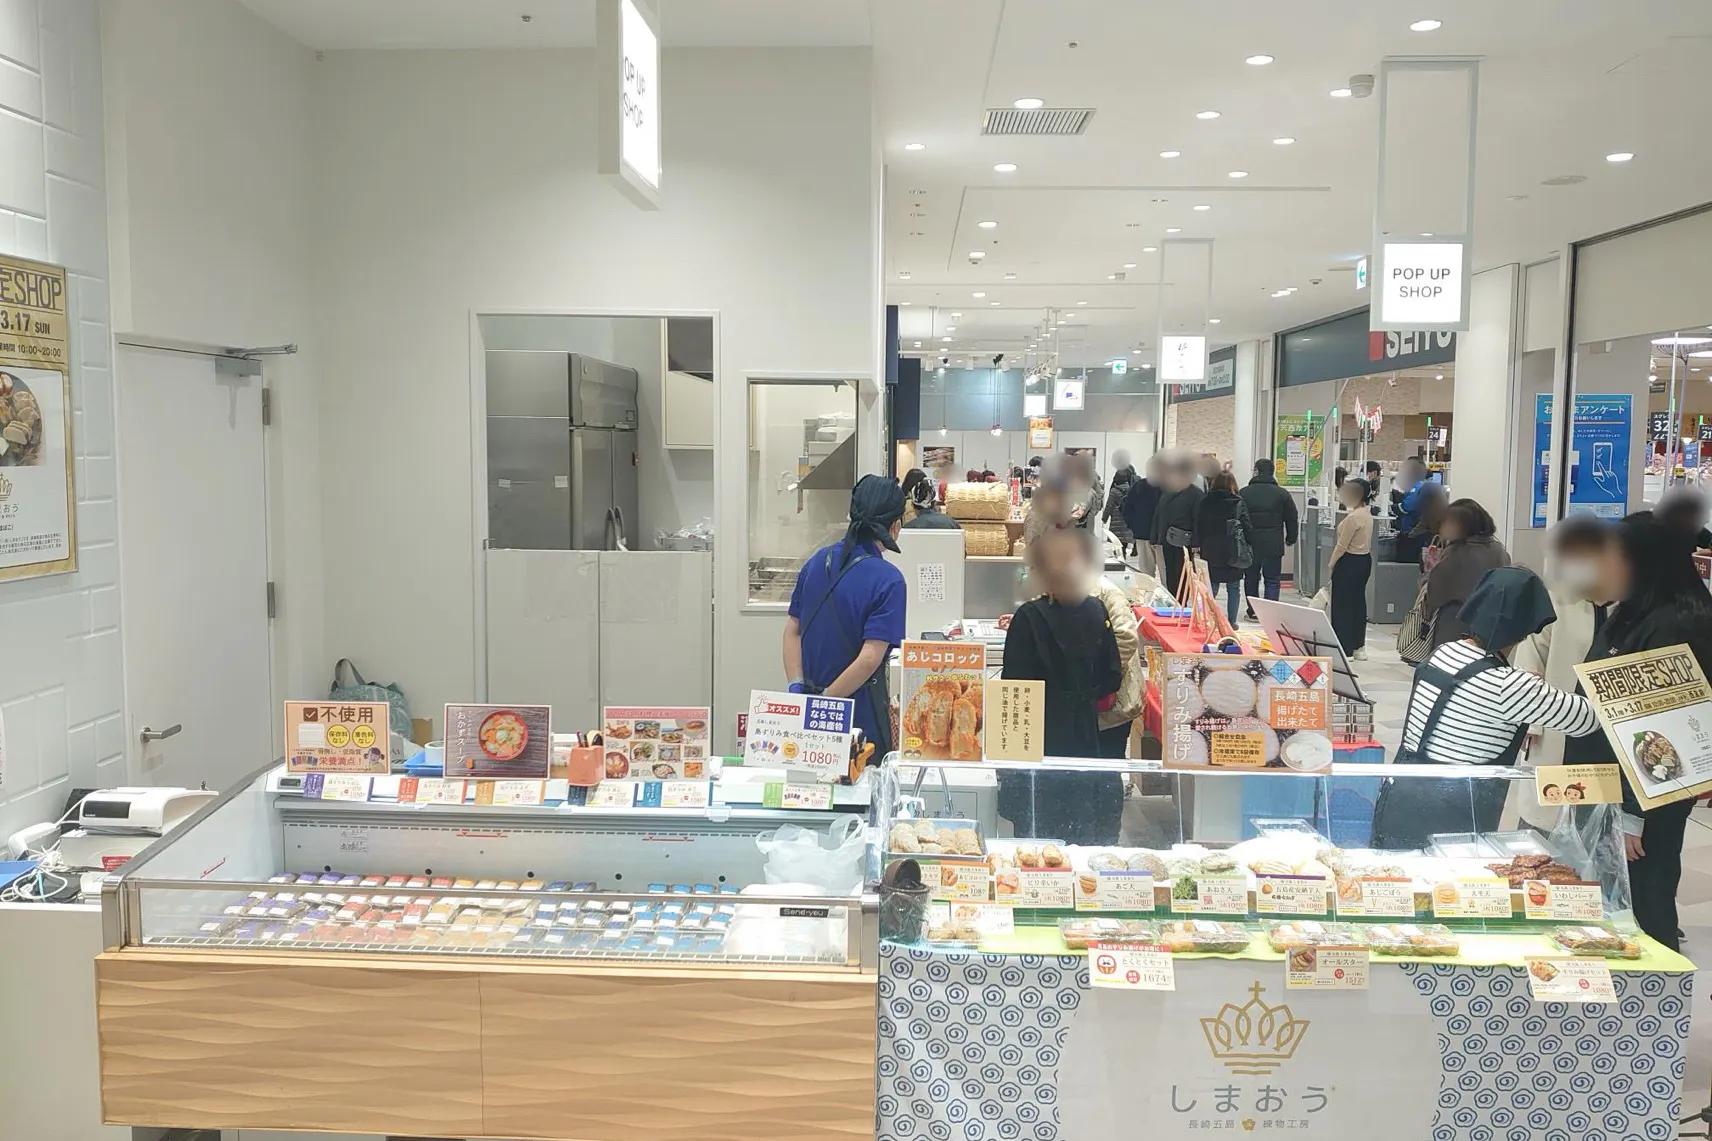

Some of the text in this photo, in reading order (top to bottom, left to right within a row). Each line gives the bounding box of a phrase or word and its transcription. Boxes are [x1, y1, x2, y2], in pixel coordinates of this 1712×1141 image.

[624, 56, 646, 96] OP UP
[623, 92, 644, 128] SHOP
[1393, 268, 1451, 280] POP UP
[1399, 286, 1443, 298] SHOP
[35, 321, 51, 335] SUN
[0, 342, 16, 352] 時間
[1544, 405, 1626, 414] おまアンケート
[1653, 420, 1670, 432] 32
[1428, 431, 1439, 439] 24
[1701, 430, 1712, 439] 21
[906, 650, 981, 665] あじコロッケ
[1274, 690, 1320, 703] 長崎五島
[811, 699, 845, 711] 長崎五島
[1012, 686, 1020, 732] 使用した商品と
[1276, 704, 1319, 716] 揚げたて
[320, 706, 374, 723] 不使用
[810, 710, 845, 721] ならでは
[1172, 668, 1193, 761] すりみ揚げ
[809, 720, 844, 732] の海産物
[1276, 716, 1319, 728] 出来たて
[456, 711, 466, 765] おかずスープ
[1122, 957, 1170, 967] とくとくセット
[1321, 958, 1364, 966] オールスター
[1171, 1084, 1329, 1113] しまおう
[1188, 1119, 1309, 1129] 長崎五島 練物工房
